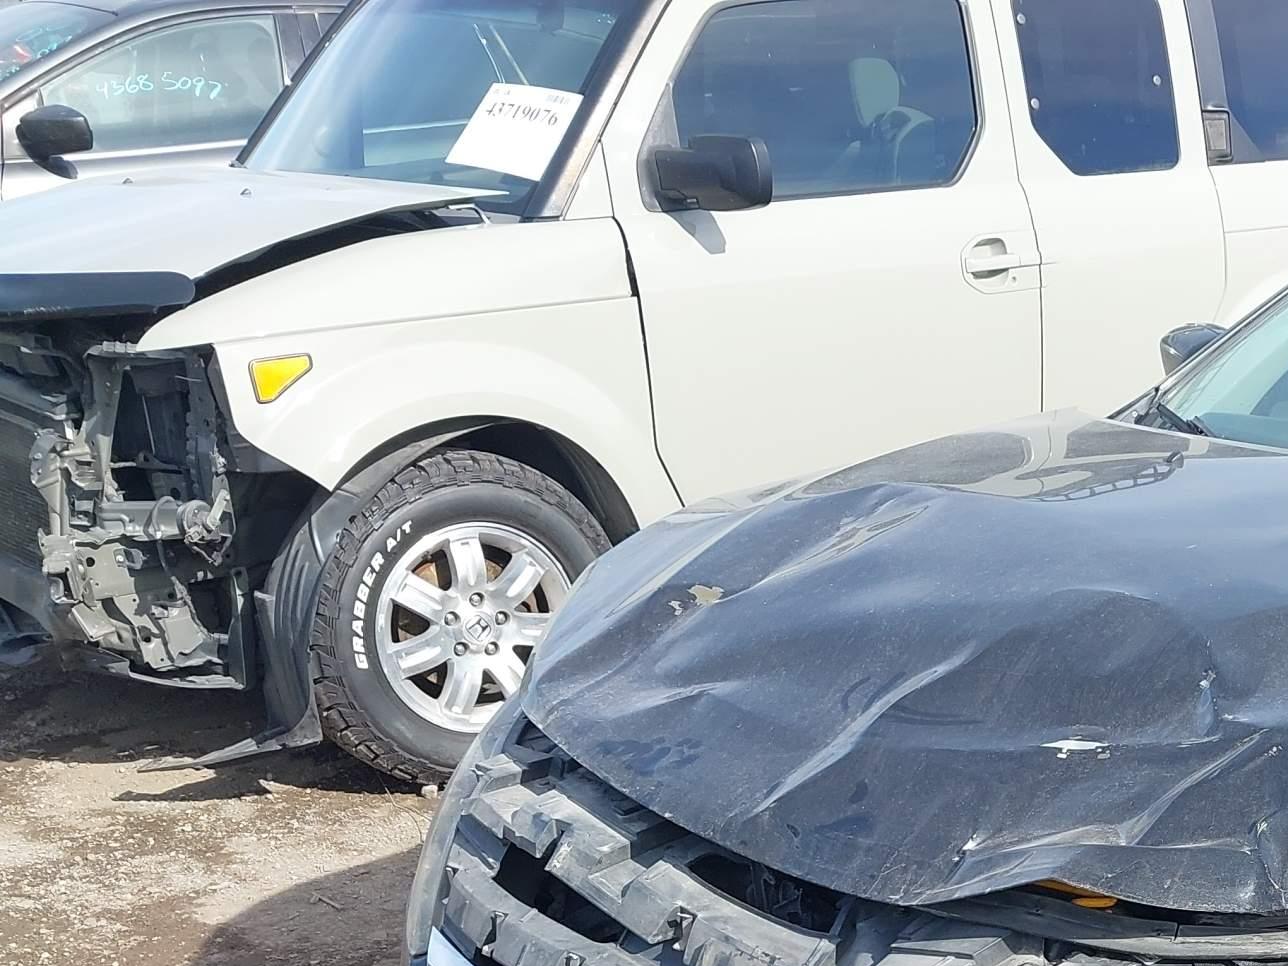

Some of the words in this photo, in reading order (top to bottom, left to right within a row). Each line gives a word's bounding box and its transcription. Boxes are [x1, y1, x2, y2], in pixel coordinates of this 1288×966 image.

[485, 101, 558, 126] 43719076
[352, 551, 385, 669] GRABBER
[386, 520, 412, 552] A/T
